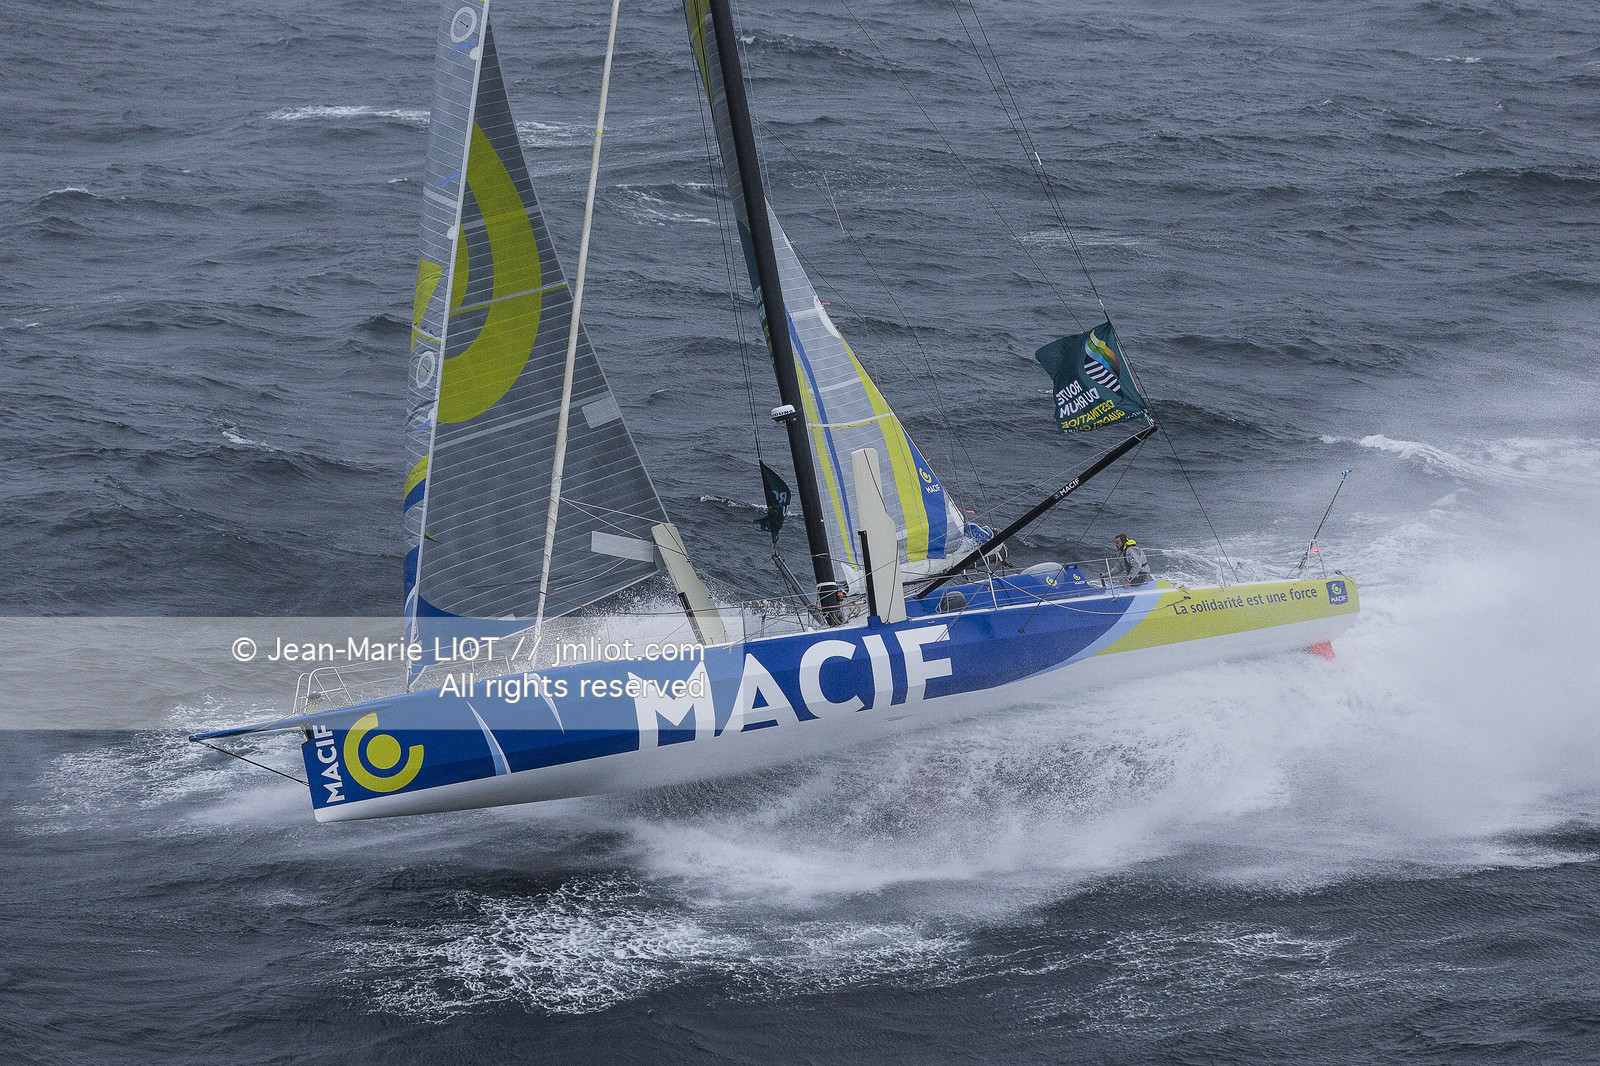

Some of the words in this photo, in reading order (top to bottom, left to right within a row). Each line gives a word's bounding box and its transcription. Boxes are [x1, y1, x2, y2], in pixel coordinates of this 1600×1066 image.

[1059, 477, 1080, 496] MACIF
[1172, 604, 1189, 615] La
[1190, 596, 1245, 613] solidarité
[1246, 594, 1265, 606] est
[1266, 592, 1288, 604] une
[1289, 588, 1318, 601] force
[627, 624, 953, 751] MACIF
[312, 724, 346, 804] MACIF
